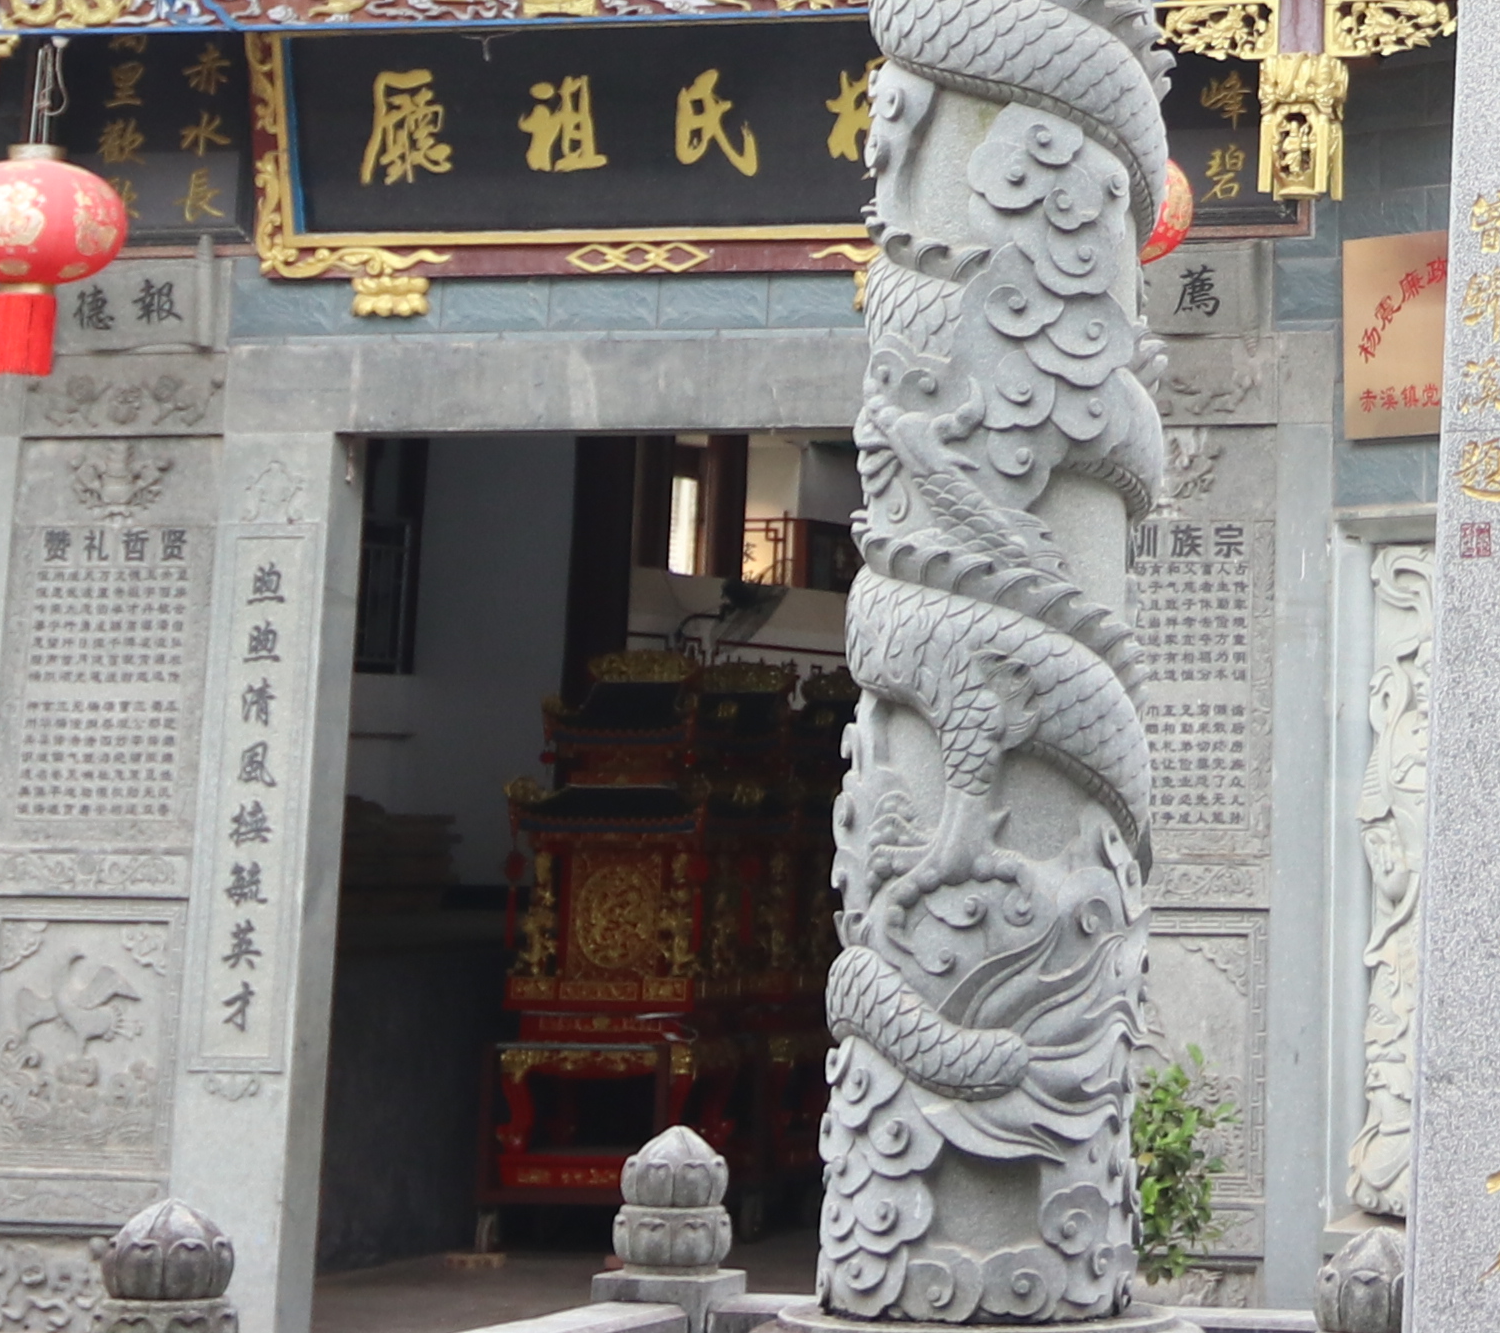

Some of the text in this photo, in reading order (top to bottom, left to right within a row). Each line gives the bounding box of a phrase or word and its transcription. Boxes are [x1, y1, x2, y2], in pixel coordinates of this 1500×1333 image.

[173, 42, 232, 222] 赤水長
[1359, 382, 1441, 414] 赤溪镇党
